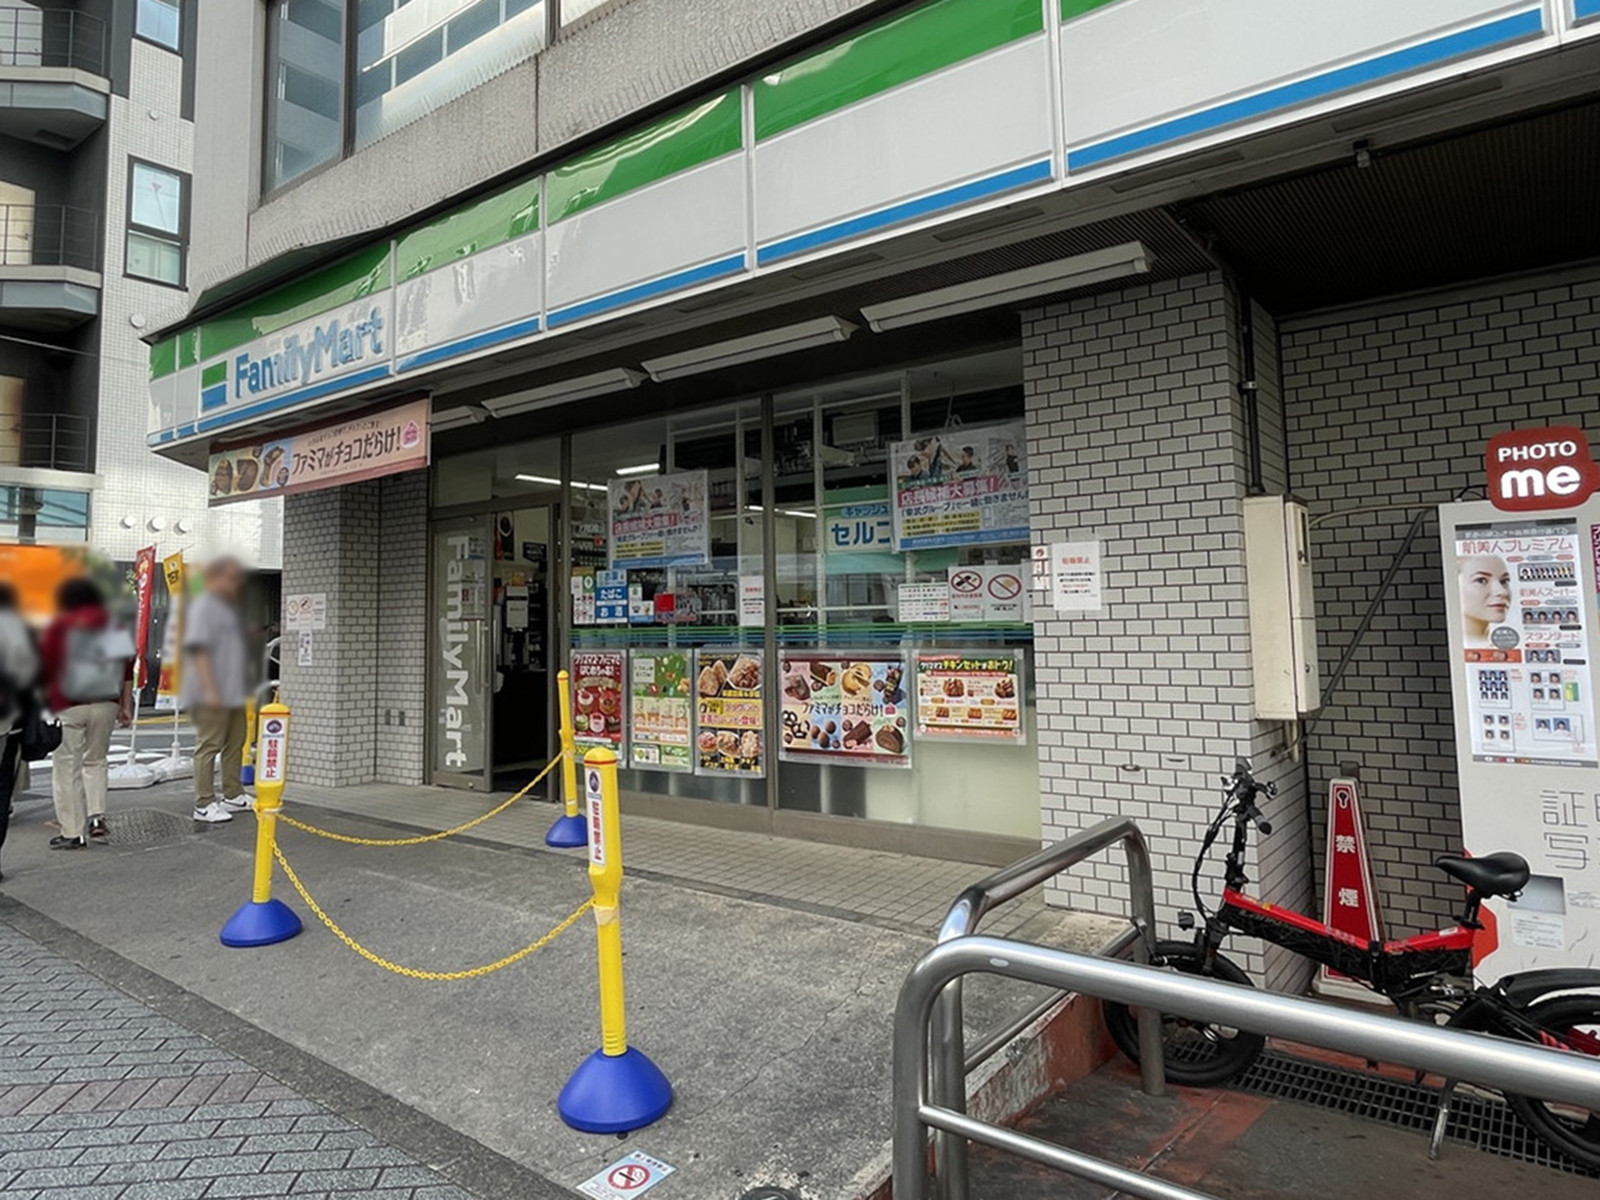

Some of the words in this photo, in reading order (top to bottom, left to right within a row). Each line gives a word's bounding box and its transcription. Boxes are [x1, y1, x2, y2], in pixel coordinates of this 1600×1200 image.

[235, 306, 384, 399] FamilyMart
[1498, 440, 1577, 463] PHOTO
[1500, 465, 1581, 498] me
[1462, 537, 1573, 554] 肌美人プレミアム
[442, 535, 469, 768] FamilyMart
[1335, 834, 1359, 908] 禁煙
